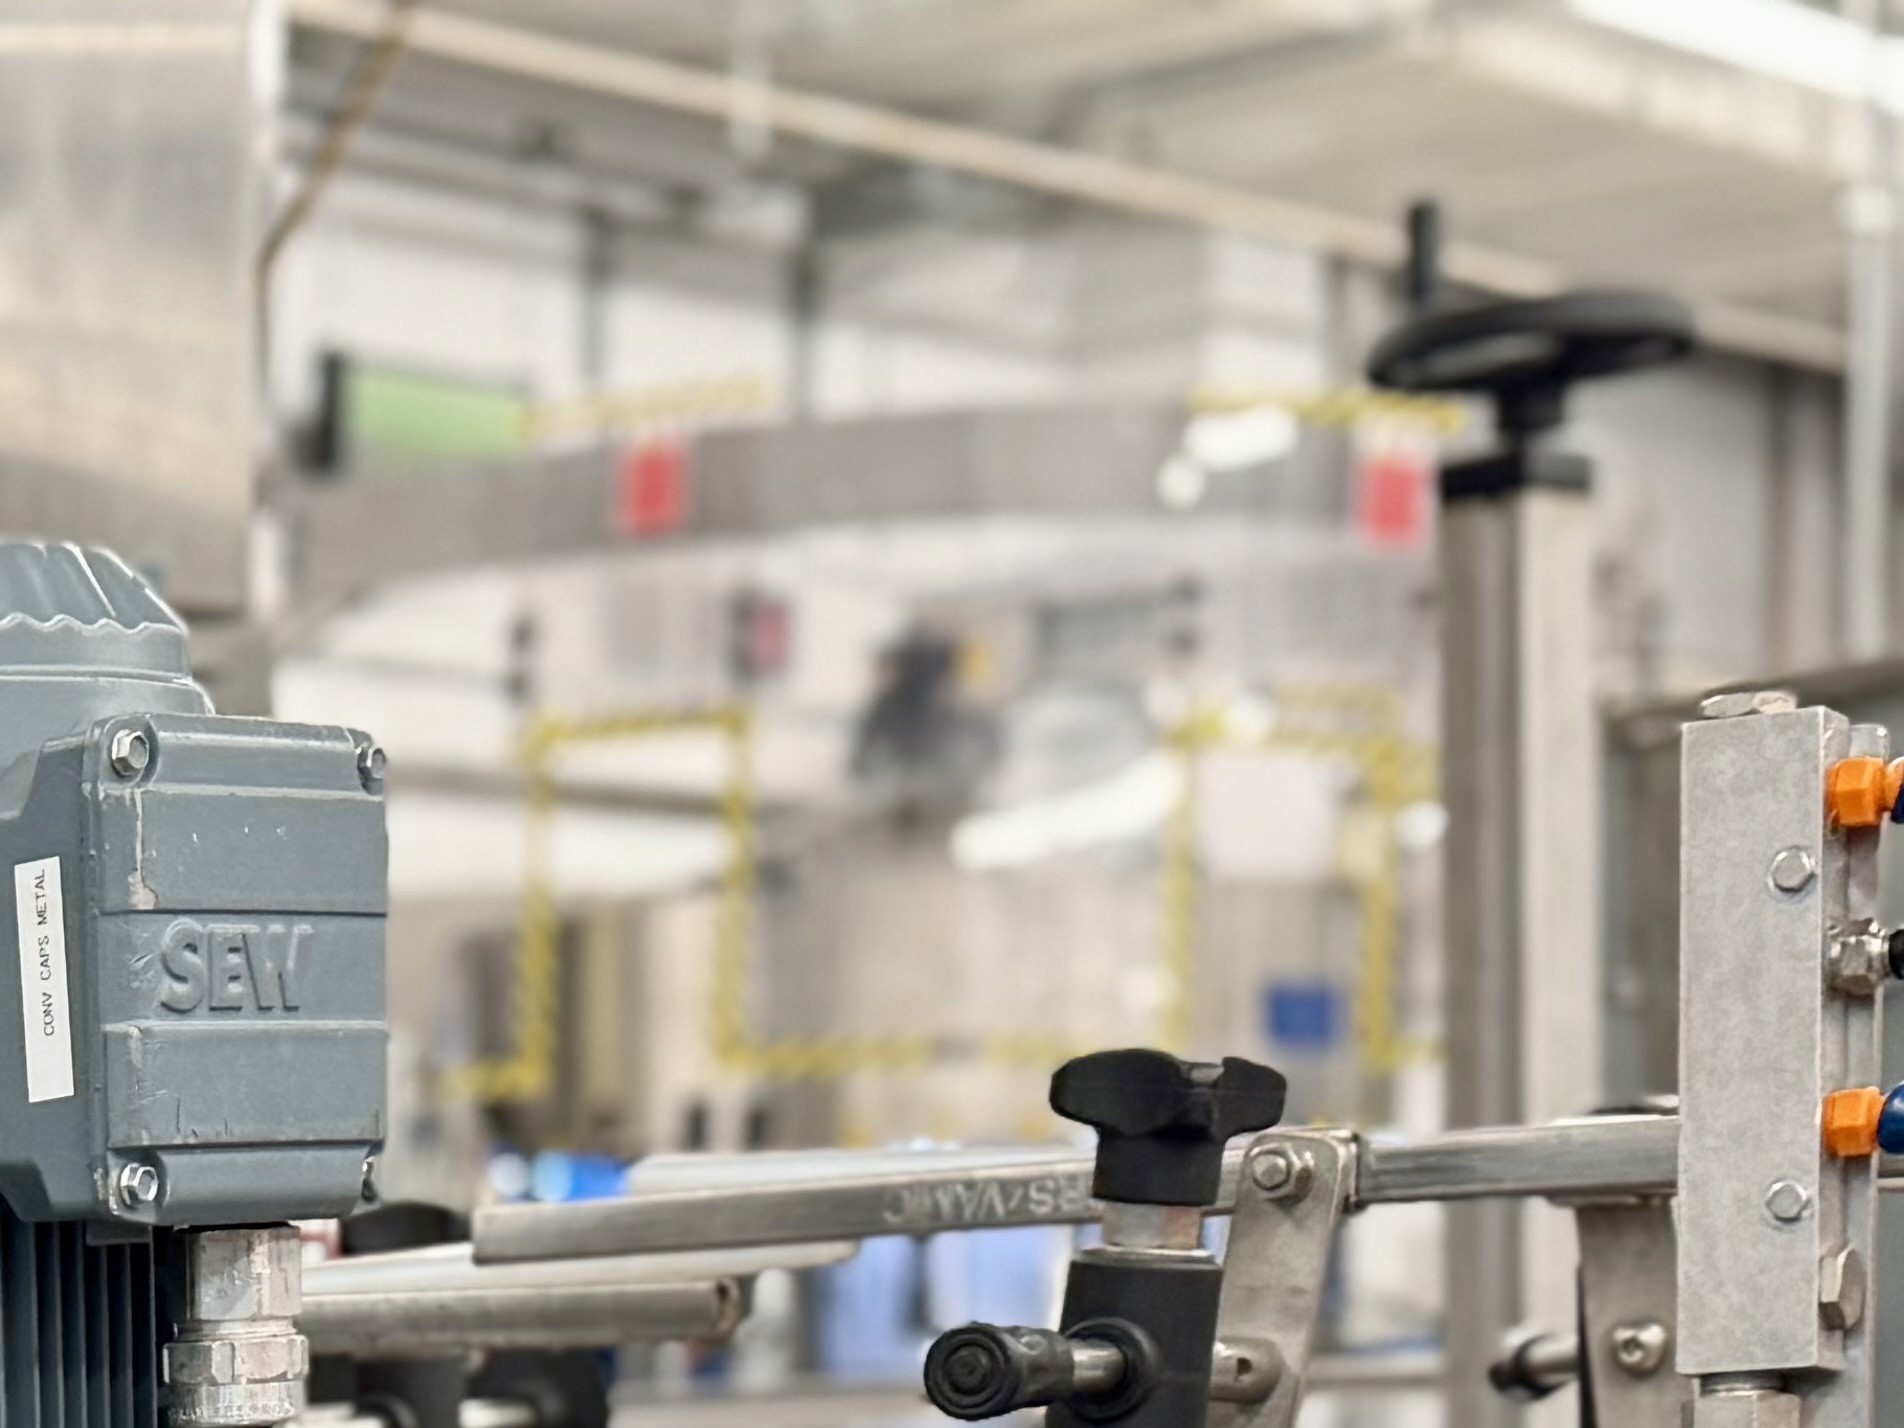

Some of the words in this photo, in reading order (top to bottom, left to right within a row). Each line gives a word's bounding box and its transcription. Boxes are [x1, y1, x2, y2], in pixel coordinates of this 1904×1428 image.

[33, 868, 48, 926] METAL
[37, 935, 52, 981] CAPS
[159, 918, 315, 1016] SEW
[41, 992, 55, 1037] CONV
